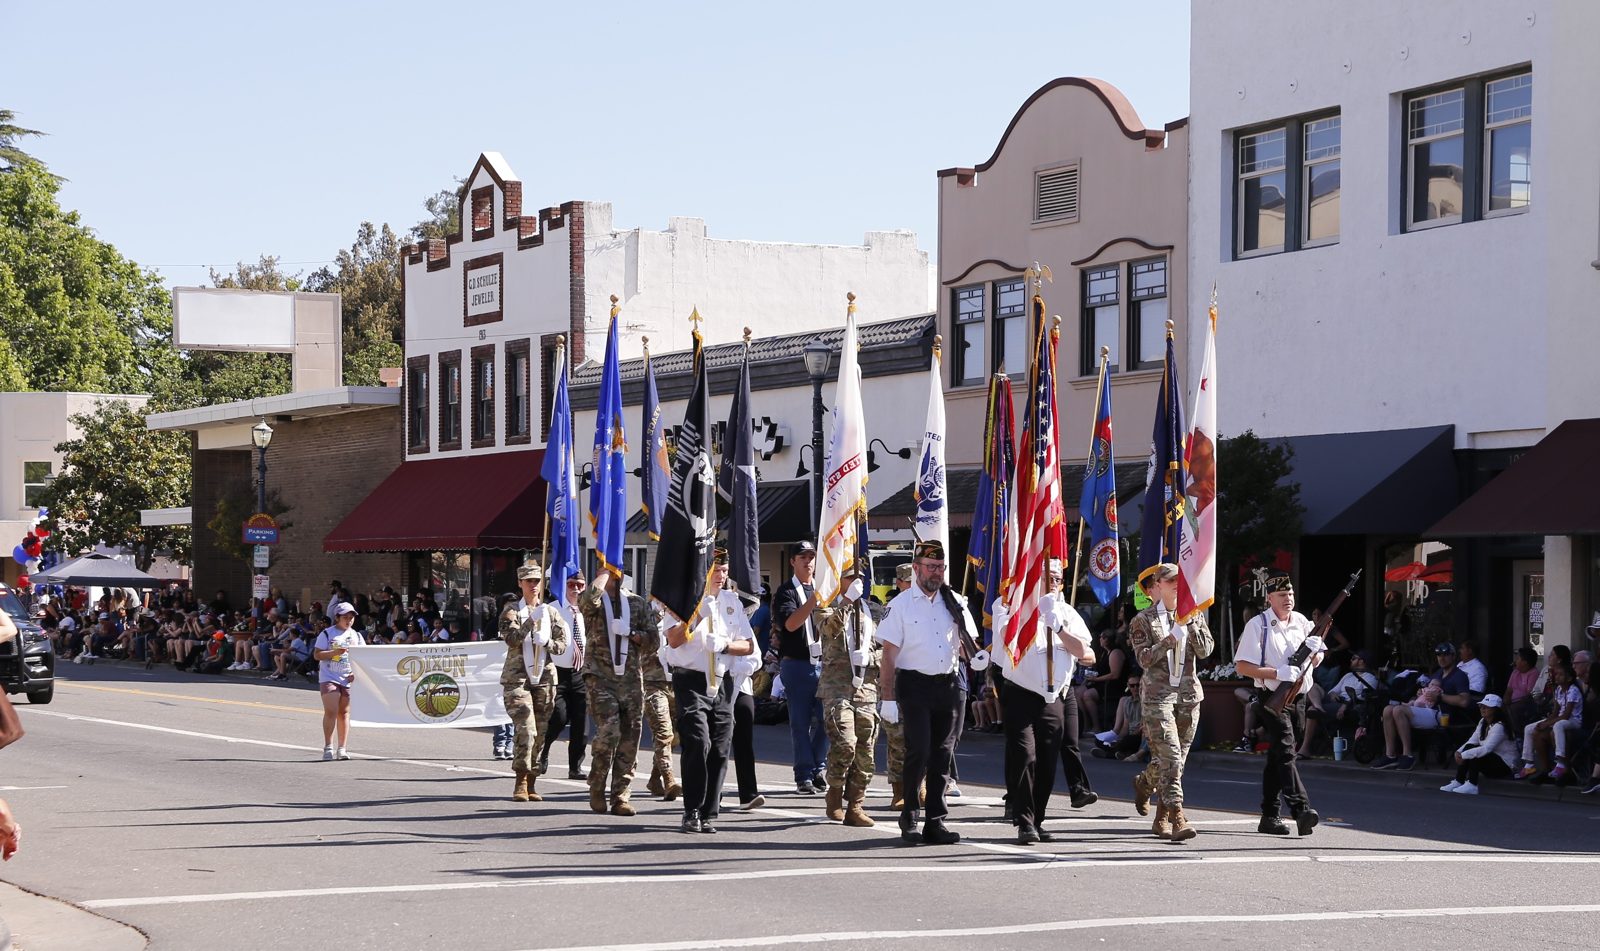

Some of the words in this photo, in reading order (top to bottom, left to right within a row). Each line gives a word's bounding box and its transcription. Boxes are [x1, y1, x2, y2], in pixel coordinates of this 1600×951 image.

[477, 273, 498, 288] SCHULZE
[471, 291, 495, 307] JEWELER
[1510, 452, 1526, 467] 10
[397, 654, 468, 684] DIXON
